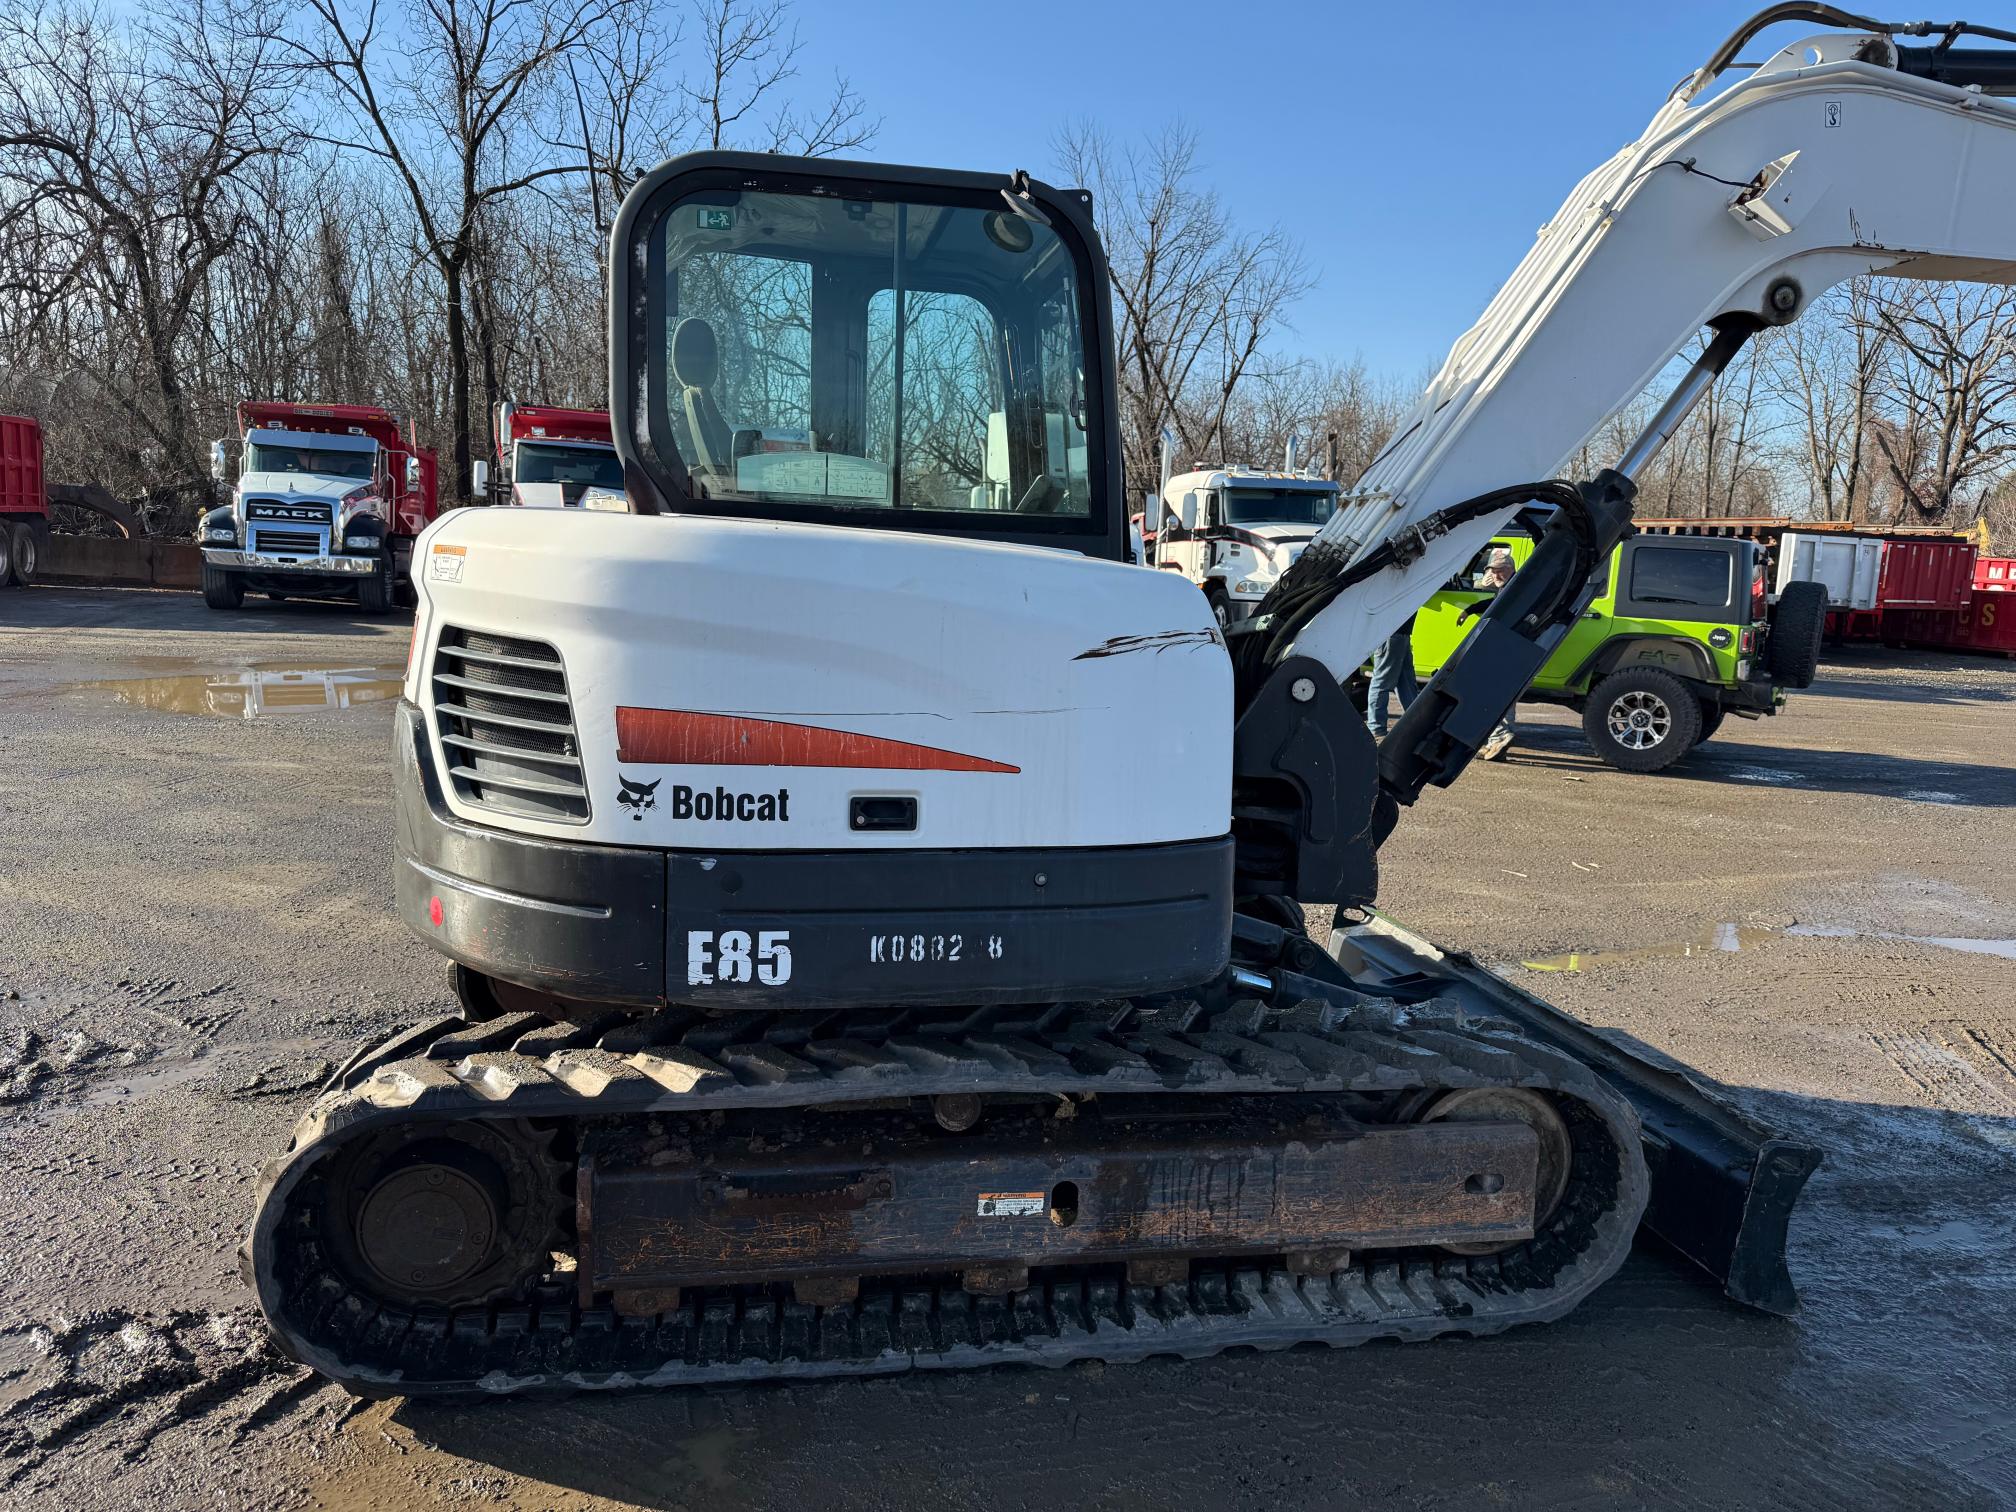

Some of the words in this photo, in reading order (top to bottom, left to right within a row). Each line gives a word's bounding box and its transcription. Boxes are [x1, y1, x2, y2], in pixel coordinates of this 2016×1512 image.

[256, 508, 324, 519] MACK
[672, 785, 789, 822] Bobcat
[687, 930, 792, 986] E85
